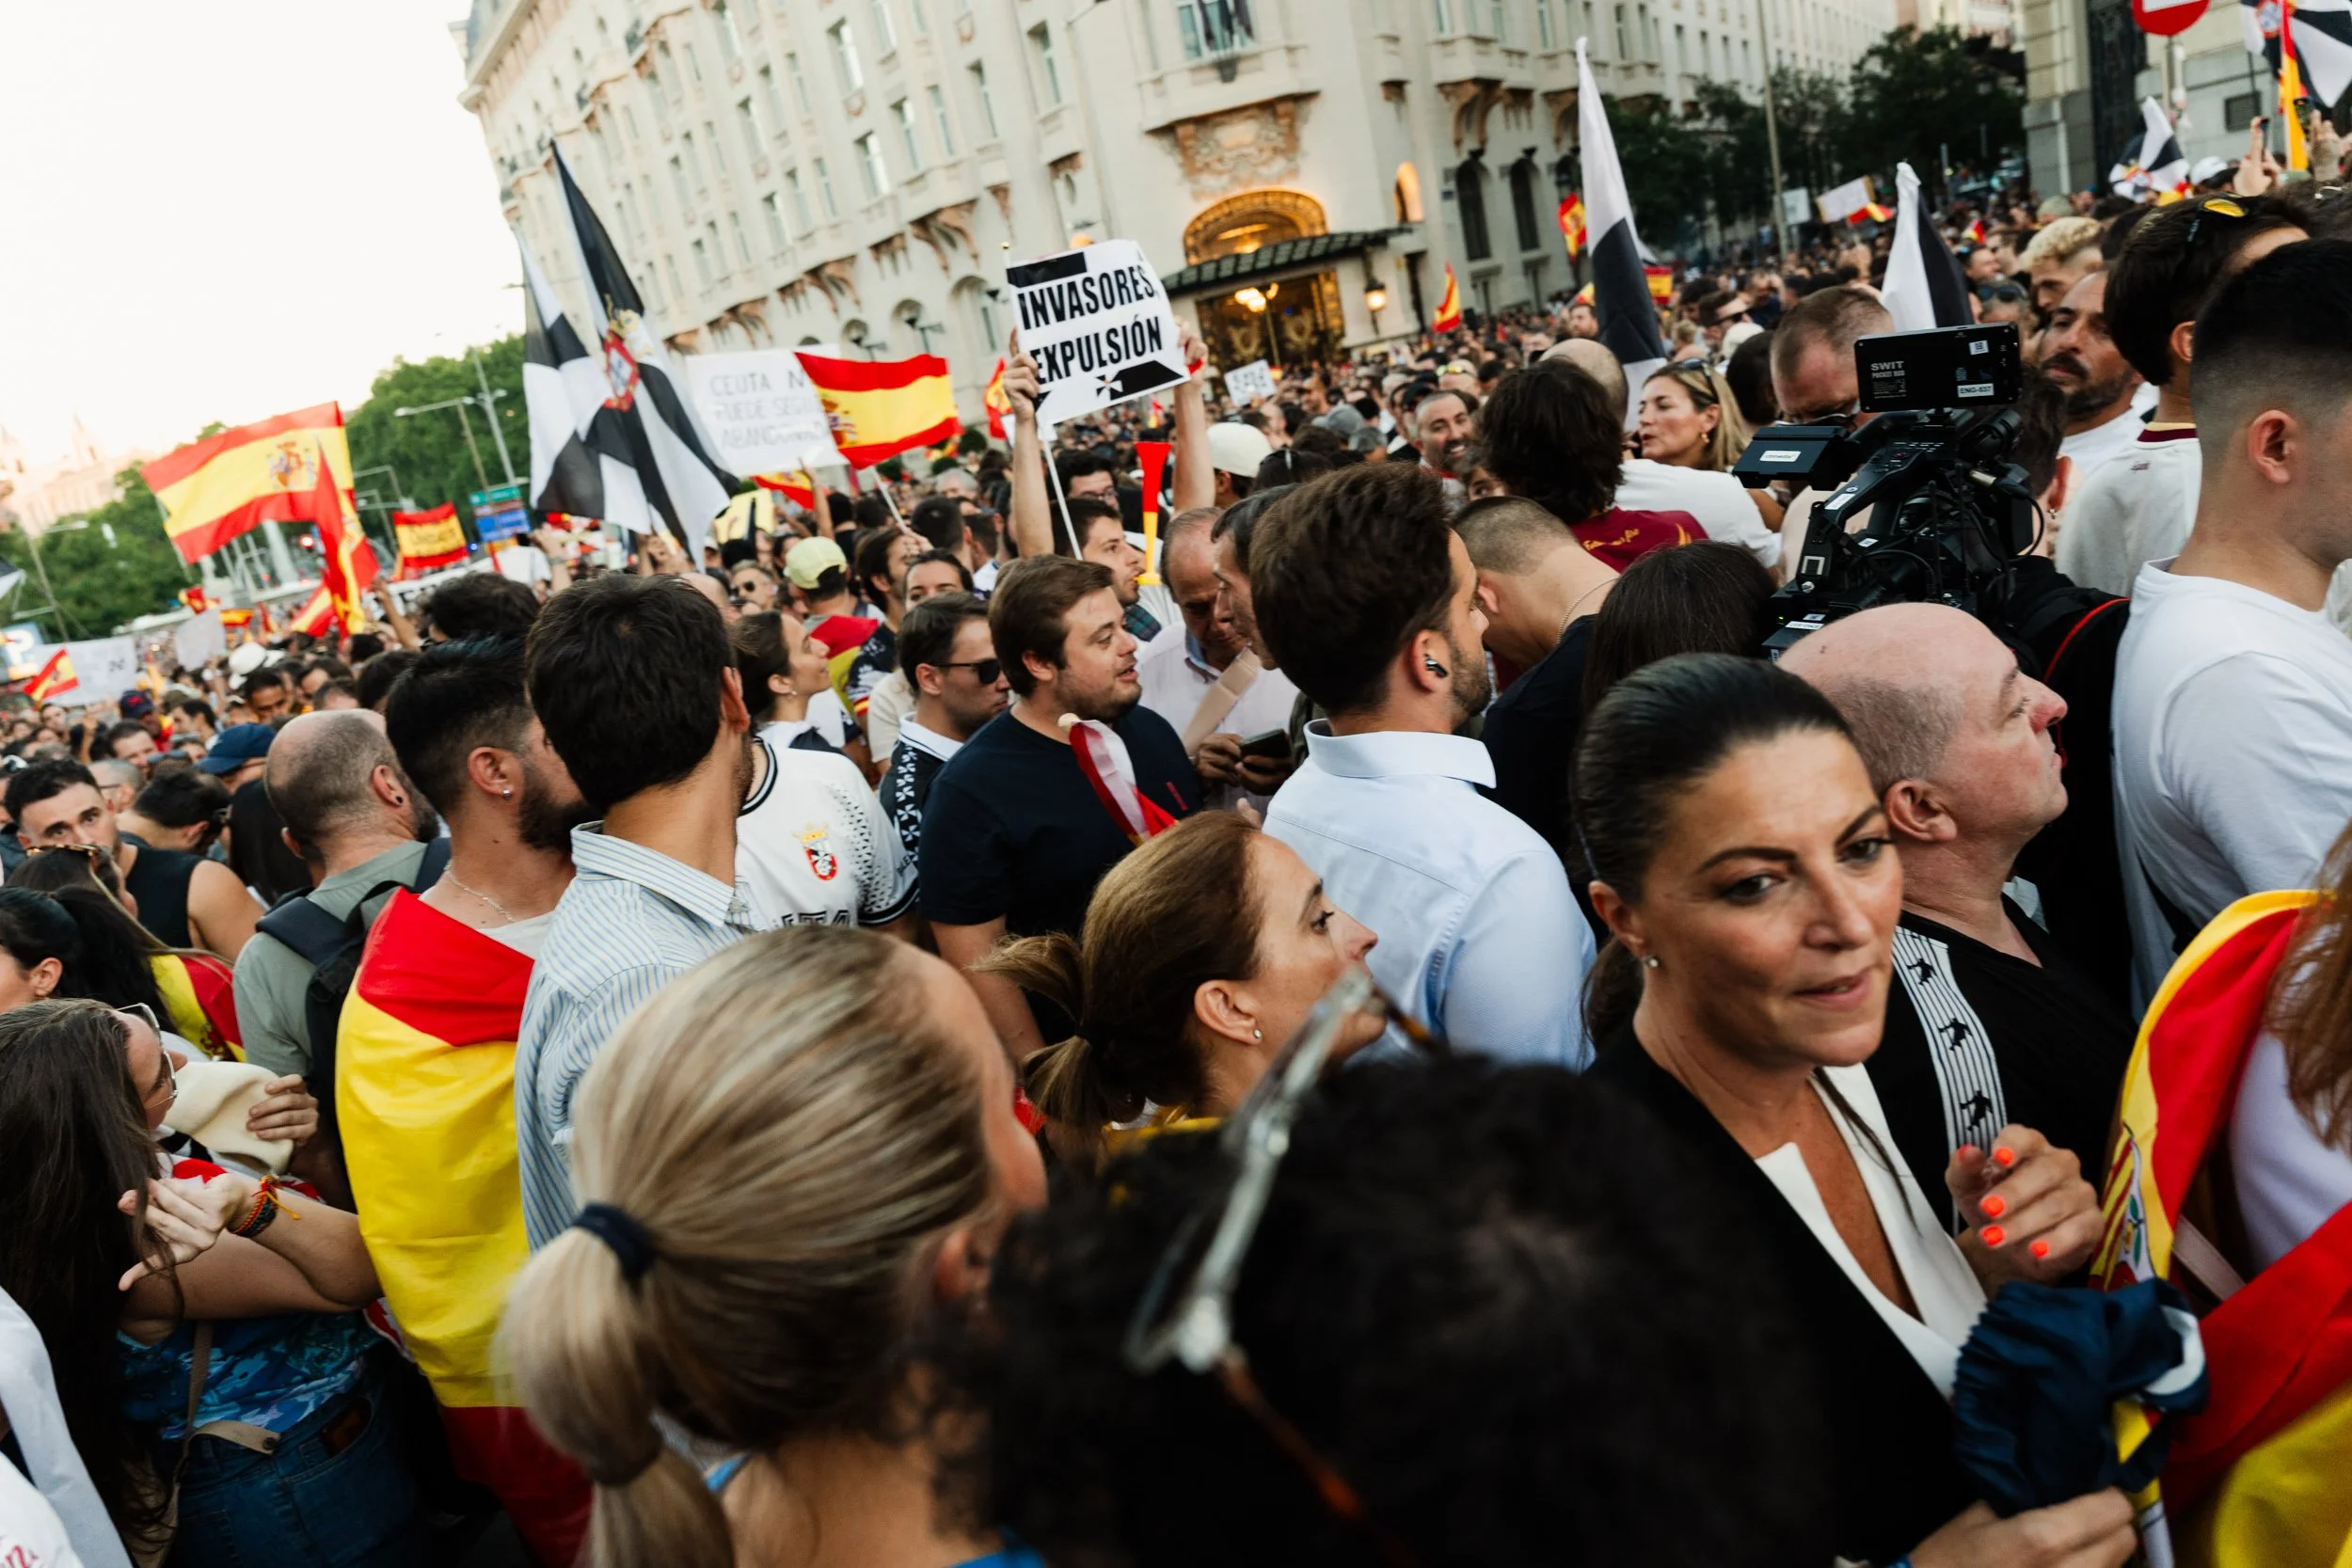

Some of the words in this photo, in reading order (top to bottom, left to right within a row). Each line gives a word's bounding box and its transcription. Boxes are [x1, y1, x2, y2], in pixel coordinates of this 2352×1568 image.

[1029, 313, 1163, 386] EXPULSIÓN
[1870, 360, 1905, 372] SWIT
[709, 372, 772, 397] CEUTA
[787, 368, 806, 388] N
